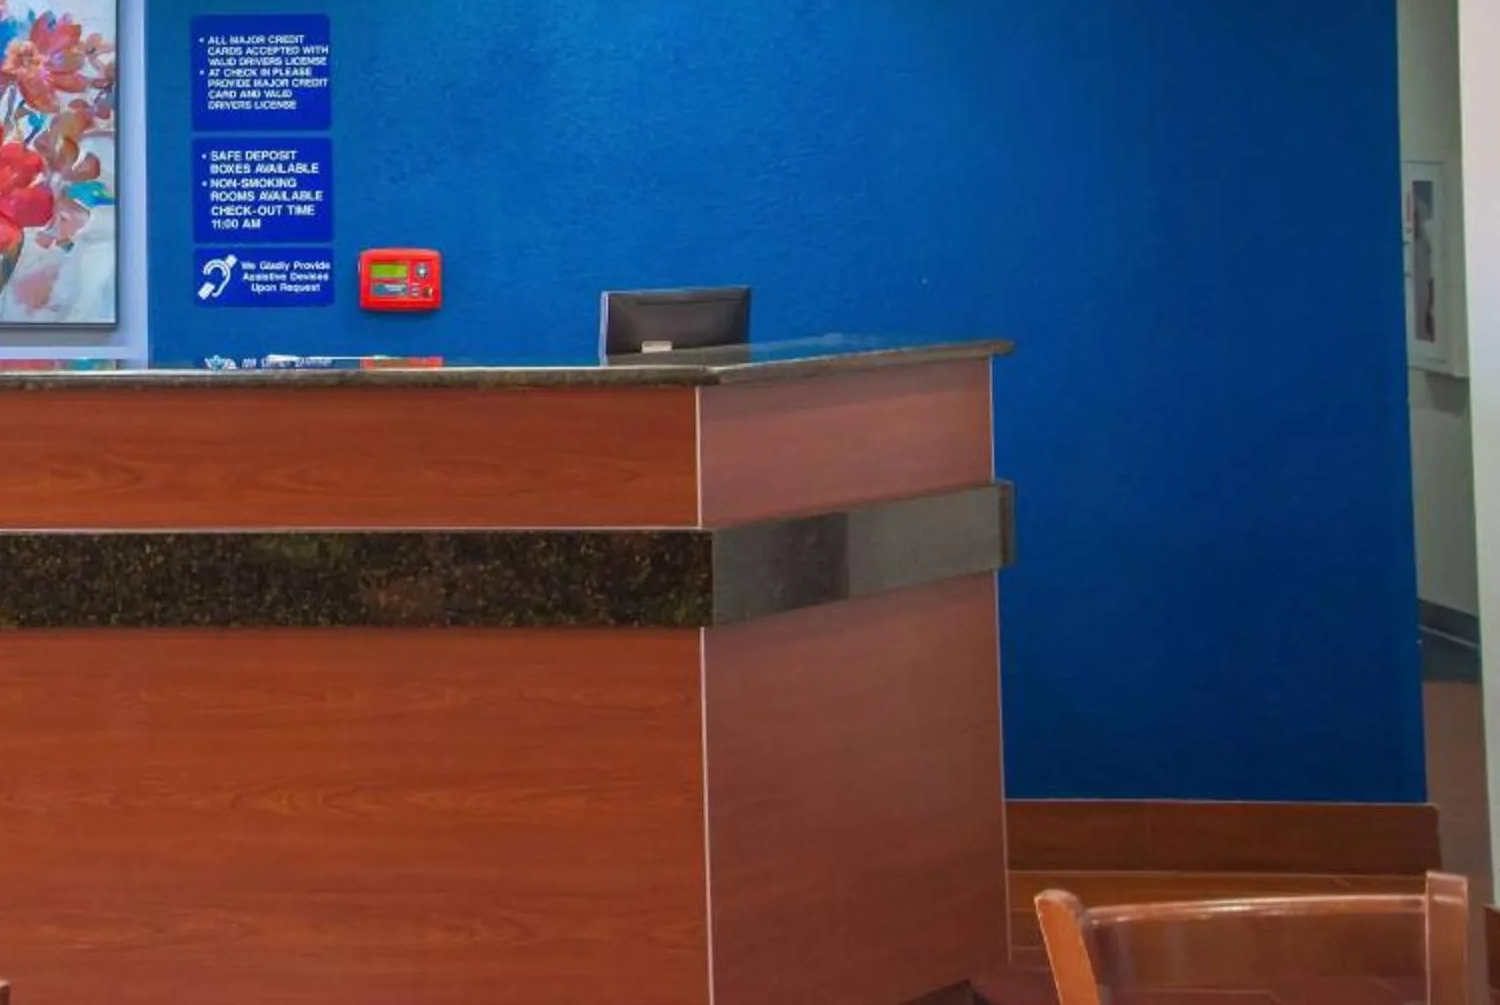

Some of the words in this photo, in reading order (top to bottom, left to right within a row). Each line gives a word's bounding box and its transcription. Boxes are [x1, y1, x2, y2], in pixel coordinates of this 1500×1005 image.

[208, 35, 227, 45] ALL
[230, 35, 266, 44] MAJOR
[268, 34, 304, 44] CREDIT
[208, 46, 243, 56] CARDS
[245, 46, 300, 55] ACCEPTED
[302, 45, 329, 54] WITH
[208, 57, 237, 66] VALID
[239, 57, 283, 65] DRIVERS
[285, 56, 327, 65] LICENSE
[208, 68, 221, 77] AT
[223, 68, 257, 77] CHECK
[260, 68, 270, 76] IN
[272, 67, 313, 76] PLEASE
[208, 78, 251, 88] PROVIDE
[253, 78, 289, 87] MAJOR
[291, 78, 328, 87] CREDIT
[208, 89, 237, 99] CARD
[239, 89, 261, 98] AND
[263, 89, 293, 98] VALID
[207, 100, 252, 110] DRIVERS
[254, 100, 297, 110] LICENSE
[210, 150, 242, 161] SAFE
[245, 150, 298, 161] DEPOSIT
[210, 163, 251, 174] BOXES
[255, 162, 319, 174] AVAILABLE
[209, 177, 297, 188] NON-SMOKING
[210, 191, 255, 202] ROOMS
[258, 190, 323, 201] AVAILABLE
[211, 204, 282, 216] CHECK-OUT
[287, 204, 315, 215] TIME
[211, 218, 239, 229] 11:00
[242, 218, 261, 229] AM
[241, 261, 256, 270] We
[260, 260, 290, 271] Gladly
[293, 260, 331, 270] Provide
[243, 272, 287, 281] Assistive
[289, 272, 329, 281] Devices
[251, 283, 277, 294] Upon
[279, 282, 321, 292] Request
